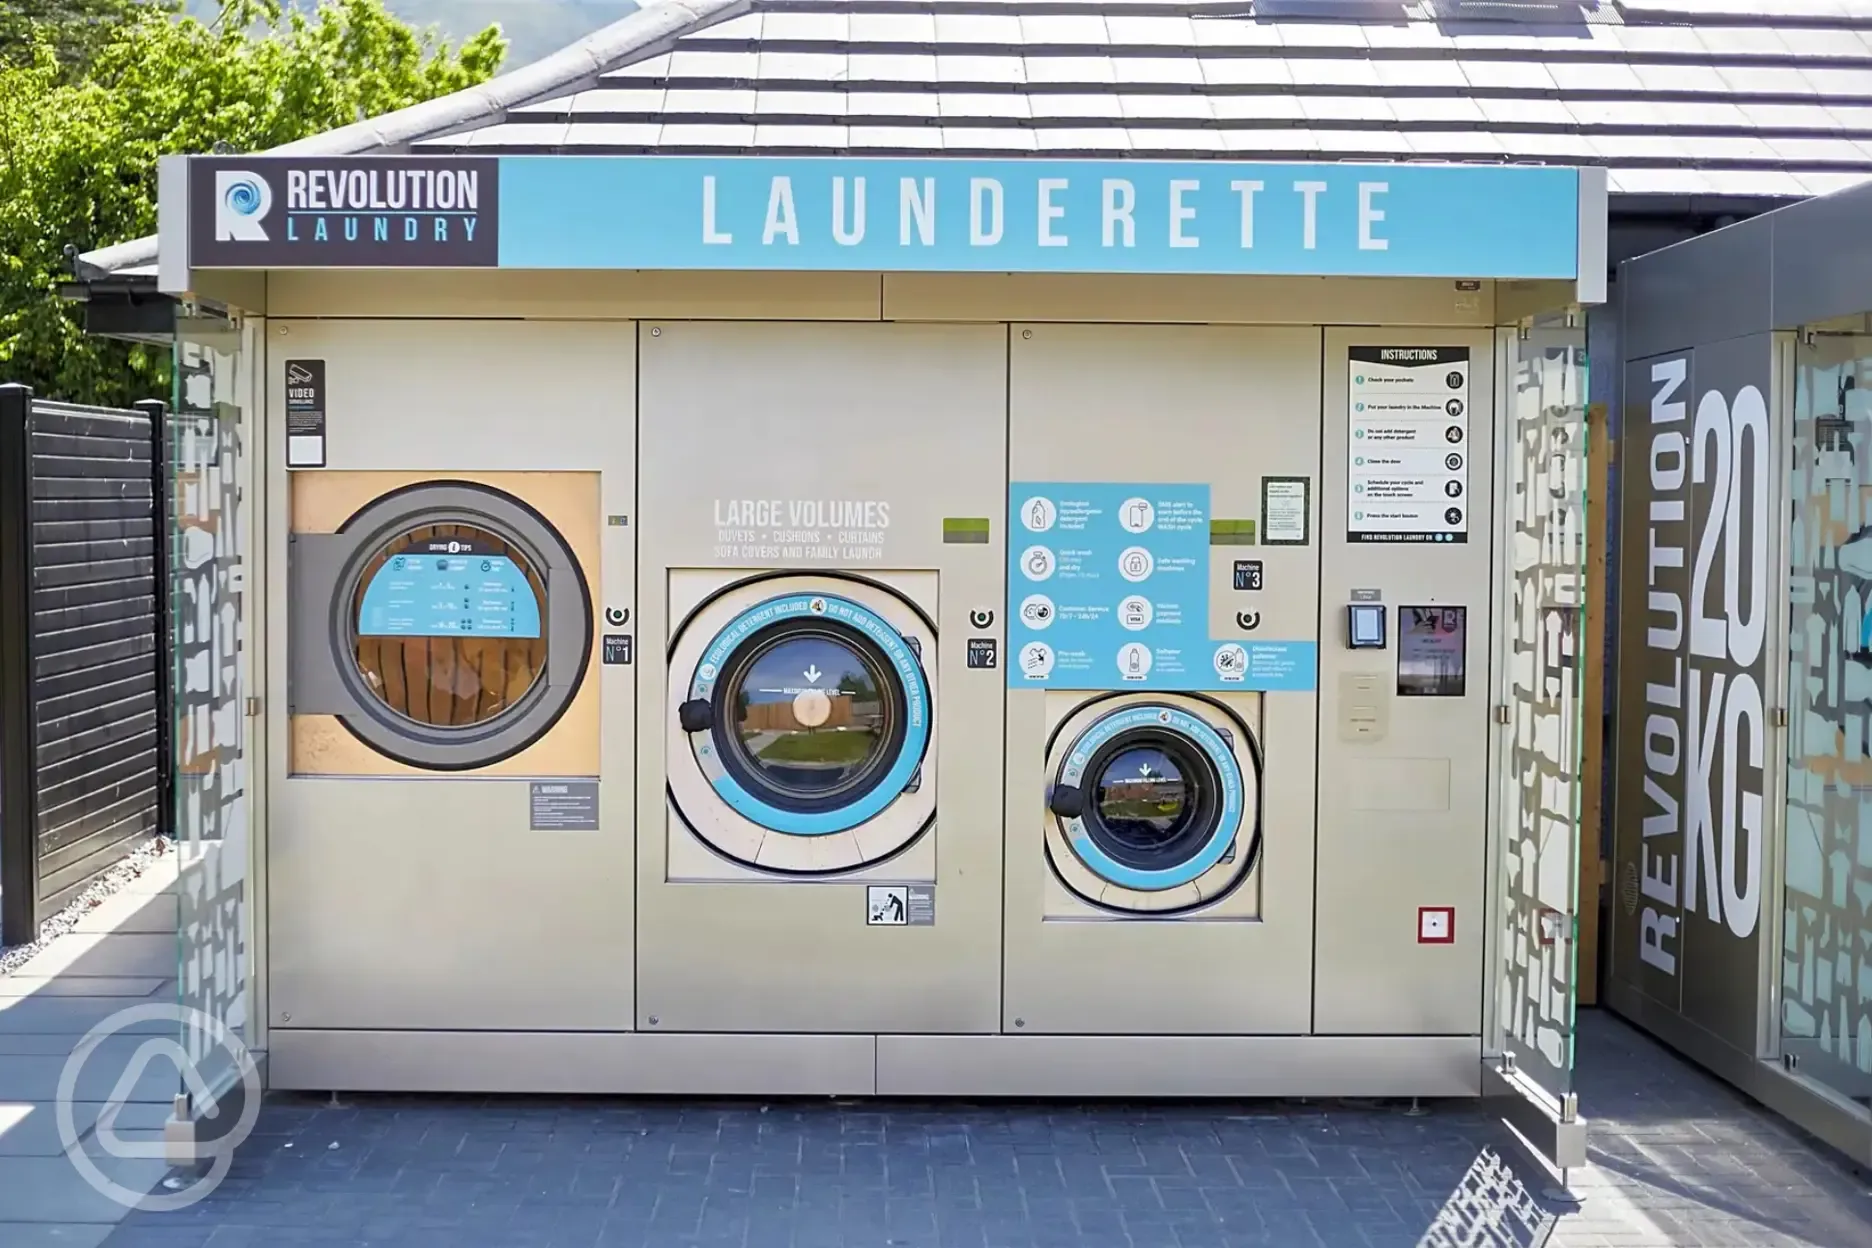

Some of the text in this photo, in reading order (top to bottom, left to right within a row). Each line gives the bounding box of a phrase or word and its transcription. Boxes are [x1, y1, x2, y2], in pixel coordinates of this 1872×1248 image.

[287, 169, 479, 210] REVOLUTION
[701, 175, 1392, 251] LAUNDERETTE
[287, 217, 478, 242] LAUNDRY
[1380, 348, 1438, 360] INSTRUCTIONS
[288, 387, 314, 398] VIDEO
[714, 499, 890, 529] LARGE VOLUMES
[1689, 383, 1770, 668] 20
[718, 530, 885, 543] DUVETS CUSHIONS CURTAINS
[715, 546, 739, 559] SOFA
[741, 546, 780, 559] COVERS
[805, 546, 839, 559] FAMILY
[1236, 563, 1260, 571] Machine
[1640, 357, 1688, 978] REVOLUTION
[1683, 668, 1764, 940] KG
